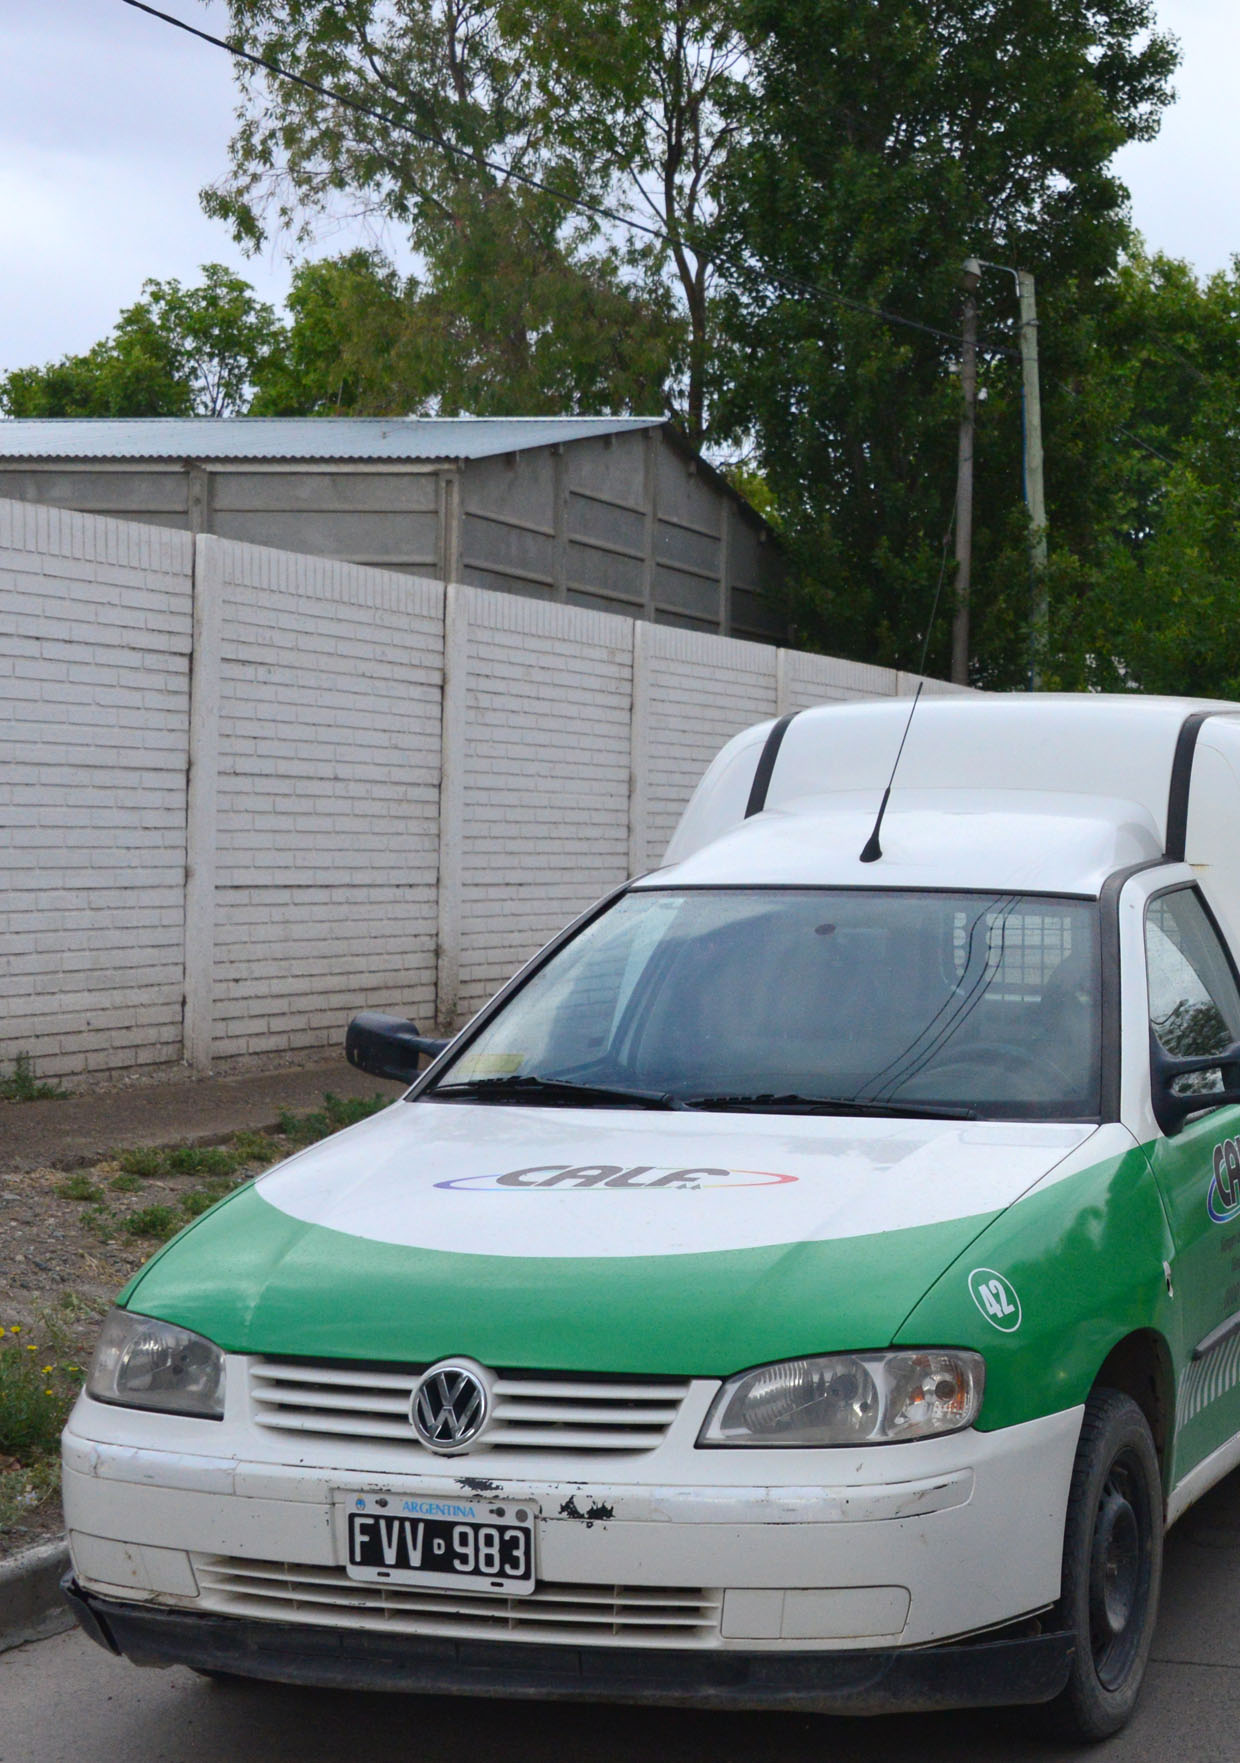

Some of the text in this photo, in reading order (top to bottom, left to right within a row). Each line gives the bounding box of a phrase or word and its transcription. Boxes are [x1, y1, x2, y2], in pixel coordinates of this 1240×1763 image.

[978, 1279, 1015, 1318] 42
[402, 1501, 476, 1518] ARGENTINA
[354, 1516, 425, 1567] FVV
[452, 1524, 526, 1577] 983
